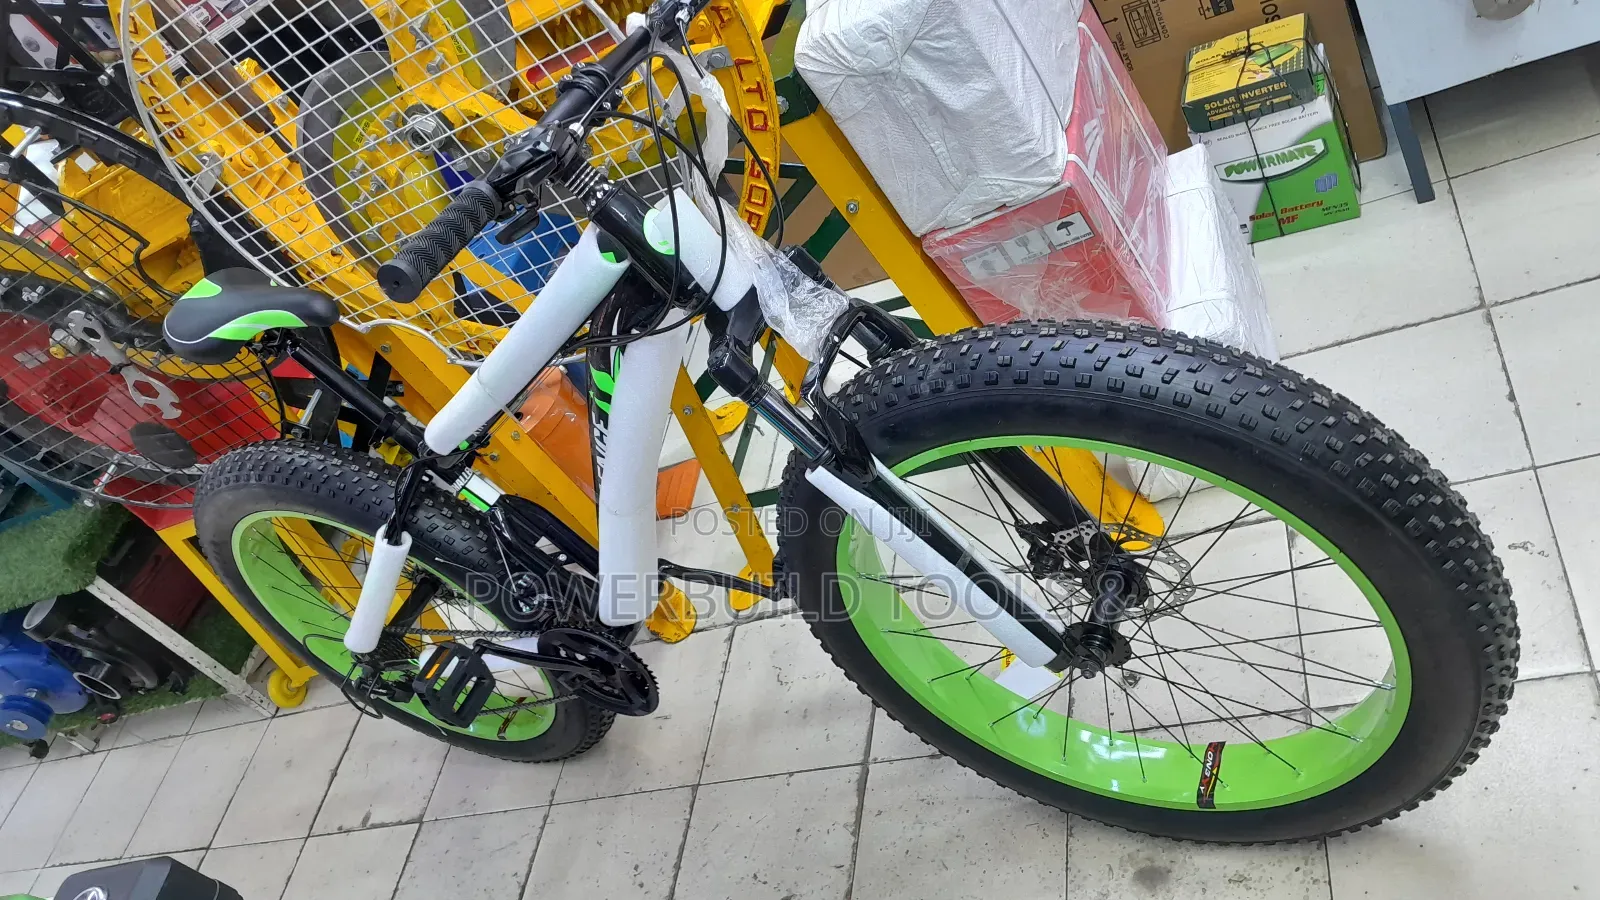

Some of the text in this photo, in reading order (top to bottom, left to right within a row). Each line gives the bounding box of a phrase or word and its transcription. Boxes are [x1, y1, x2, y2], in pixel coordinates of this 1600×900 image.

[1204, 95, 1236, 111] SOLAR
[1240, 81, 1288, 100] INVERTER
[1206, 103, 1240, 117] ADVANCED
[1223, 143, 1318, 178] POWERMATE
[1249, 210, 1275, 222] Solar
[1280, 200, 1324, 215] Battery
[1278, 213, 1299, 226] MF
